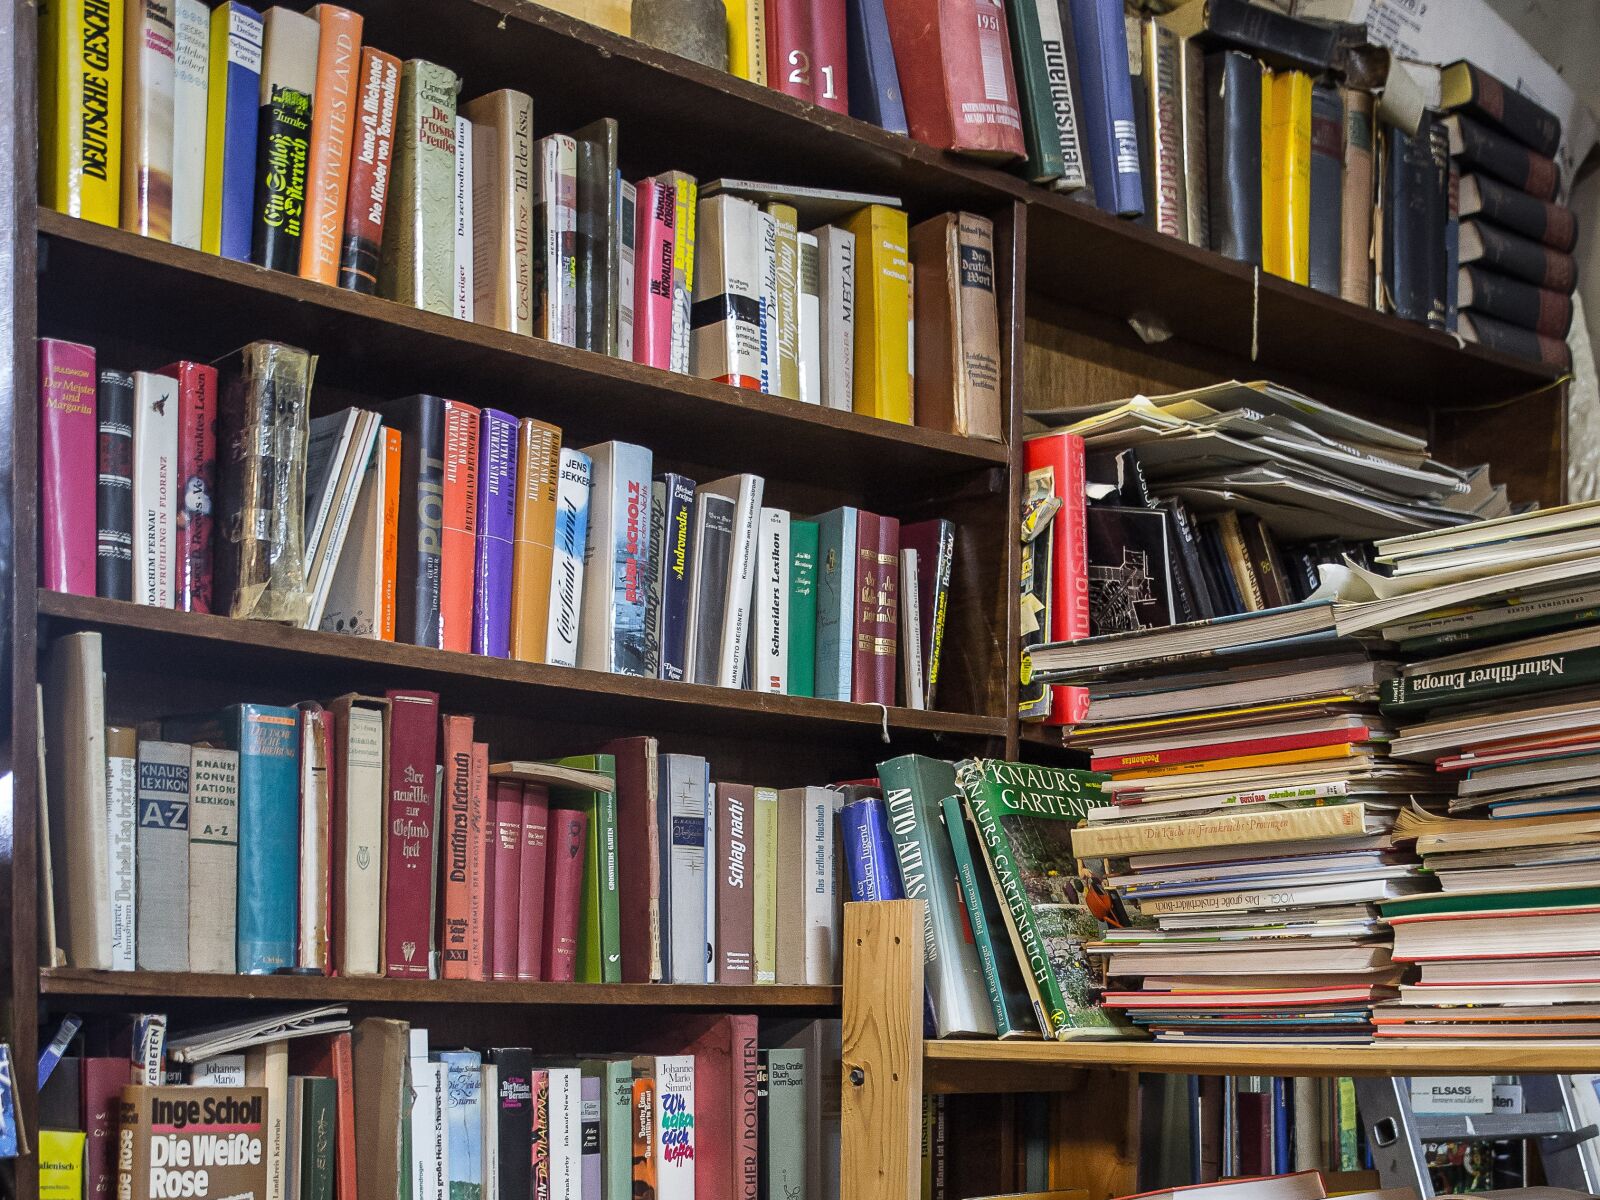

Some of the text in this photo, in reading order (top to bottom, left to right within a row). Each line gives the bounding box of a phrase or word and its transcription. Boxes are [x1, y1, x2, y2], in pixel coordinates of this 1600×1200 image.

[788, 49, 810, 85] 2
[820, 65, 838, 100] 1
[82, 72, 108, 182] DEUTSCHE
[360, 55, 384, 165] James Michener
[319, 34, 353, 265] FERNES WEITES LAND
[368, 61, 399, 225] Die Kinder von Torremolinos
[514, 109, 530, 194] Tal der Issa
[457, 121, 466, 237] Das zerbrochene Haus
[664, 184, 675, 229] ROBBINS
[650, 278, 661, 296] DIE
[661, 239, 673, 299] MORALISTEN
[840, 239, 852, 323] METALL
[62, 380, 95, 395] Meister
[447, 408, 460, 483] JULIUS TINZMANN
[458, 410, 469, 465] DAS KLAVIER
[499, 421, 510, 477] DAS KLAVIER
[465, 413, 476, 531] DEUTSCHLAND DEUTSCHLAND
[489, 418, 501, 496] JULIUS TINZMANN
[565, 458, 588, 474] JENS
[158, 455, 168, 525] IN FLORENZ
[148, 508, 157, 607] JOACHIM FERNAU
[625, 480, 640, 603] BUBI SCHOLZ
[770, 532, 781, 657] Schneiders Lexikon
[731, 607, 744, 684] HANS-OTTO MEISSNER
[1412, 657, 1566, 692] Naturführer Europa
[140, 763, 190, 779] KNAURS
[194, 771, 236, 784] KONVER
[195, 759, 237, 771] KNAURS
[1121, 753, 1160, 766] Pocahontas
[140, 778, 189, 793] LEXIKON
[991, 763, 1081, 793] KNAURS
[141, 800, 188, 830] A-Z
[194, 796, 236, 807] LEXIKON
[203, 824, 229, 837] A-Z
[727, 797, 746, 889] Schlag nach!
[815, 803, 825, 894] Das ärztliche Hausbuch
[856, 823, 872, 862] Jugend
[402, 840, 421, 859] heit
[1221, 895, 1243, 909] große
[1244, 894, 1260, 907] Das
[994, 854, 1050, 984] GARTENBUCH
[204, 1063, 242, 1076] Johannes
[213, 1074, 236, 1085] Mario
[668, 1073, 691, 1084] Mario
[772, 1062, 803, 1071] Das Große
[772, 1070, 789, 1079] Buch
[788, 1078, 803, 1087] Sport
[744, 1036, 758, 1140] DOLOMITEN
[1431, 1086, 1472, 1096] ELSASS
[151, 1095, 262, 1130] Inge Scholl
[118, 1129, 134, 1170] Rose
[150, 1133, 262, 1167] Die Weiße
[274, 1117, 282, 1157] Karlsruhe
[149, 1168, 209, 1199] Rose
[273, 1159, 281, 1199] Landkreis
